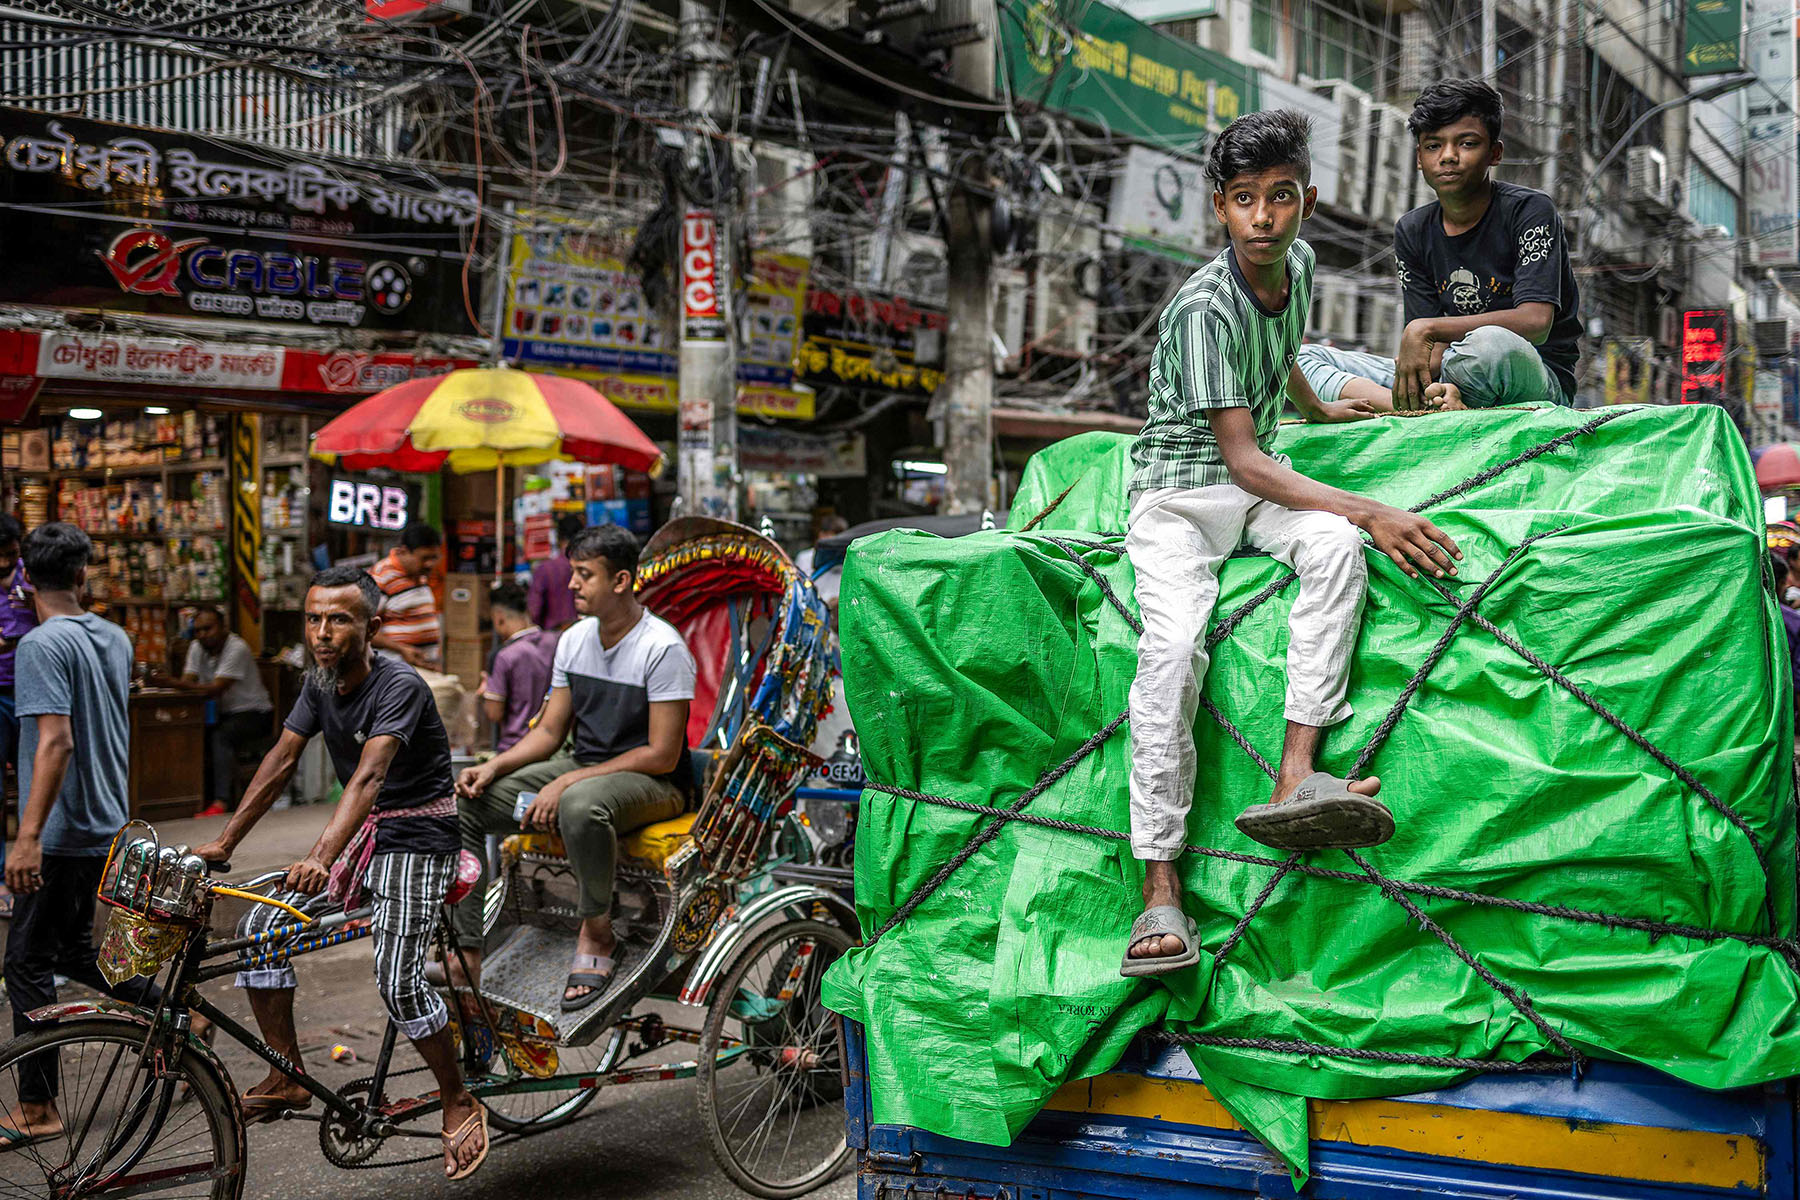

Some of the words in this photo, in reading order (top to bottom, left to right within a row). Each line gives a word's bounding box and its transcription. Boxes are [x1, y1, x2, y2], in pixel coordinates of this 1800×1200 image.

[5, 120, 162, 194] চৌধুরী
[165, 148, 361, 214] ইলেকট্রিক
[188, 246, 368, 301] CABLE
[684, 218, 715, 312] UCC
[53, 338, 119, 372] চৌধুরী
[218, 352, 277, 376] মার্কেট
[329, 479, 408, 531] BRB
[1058, 1003, 1095, 1016] KOREA
[1100, 1006, 1111, 1016] IN
